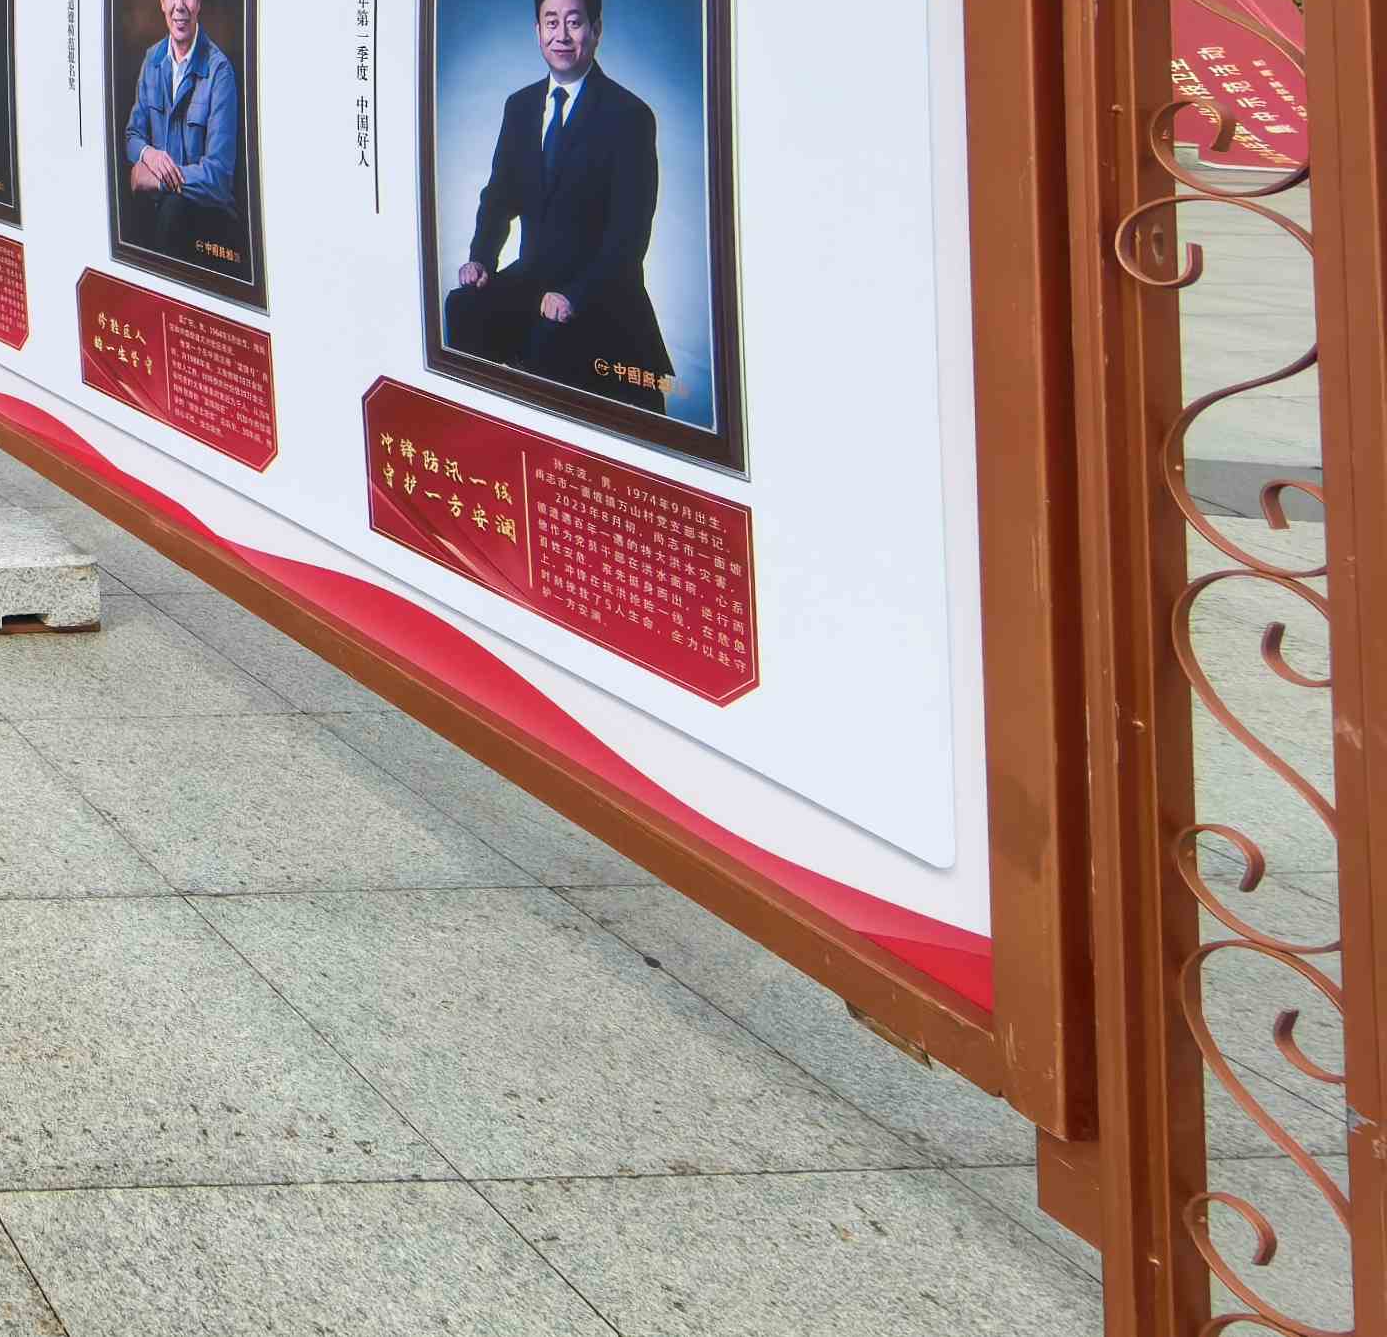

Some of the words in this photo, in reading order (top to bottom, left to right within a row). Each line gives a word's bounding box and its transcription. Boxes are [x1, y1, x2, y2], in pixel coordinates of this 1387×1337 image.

[356, 95, 370, 168] 中国好人
[379, 430, 514, 506] 冲锋防汛一线
[382, 461, 517, 545] 守护一方安澜
